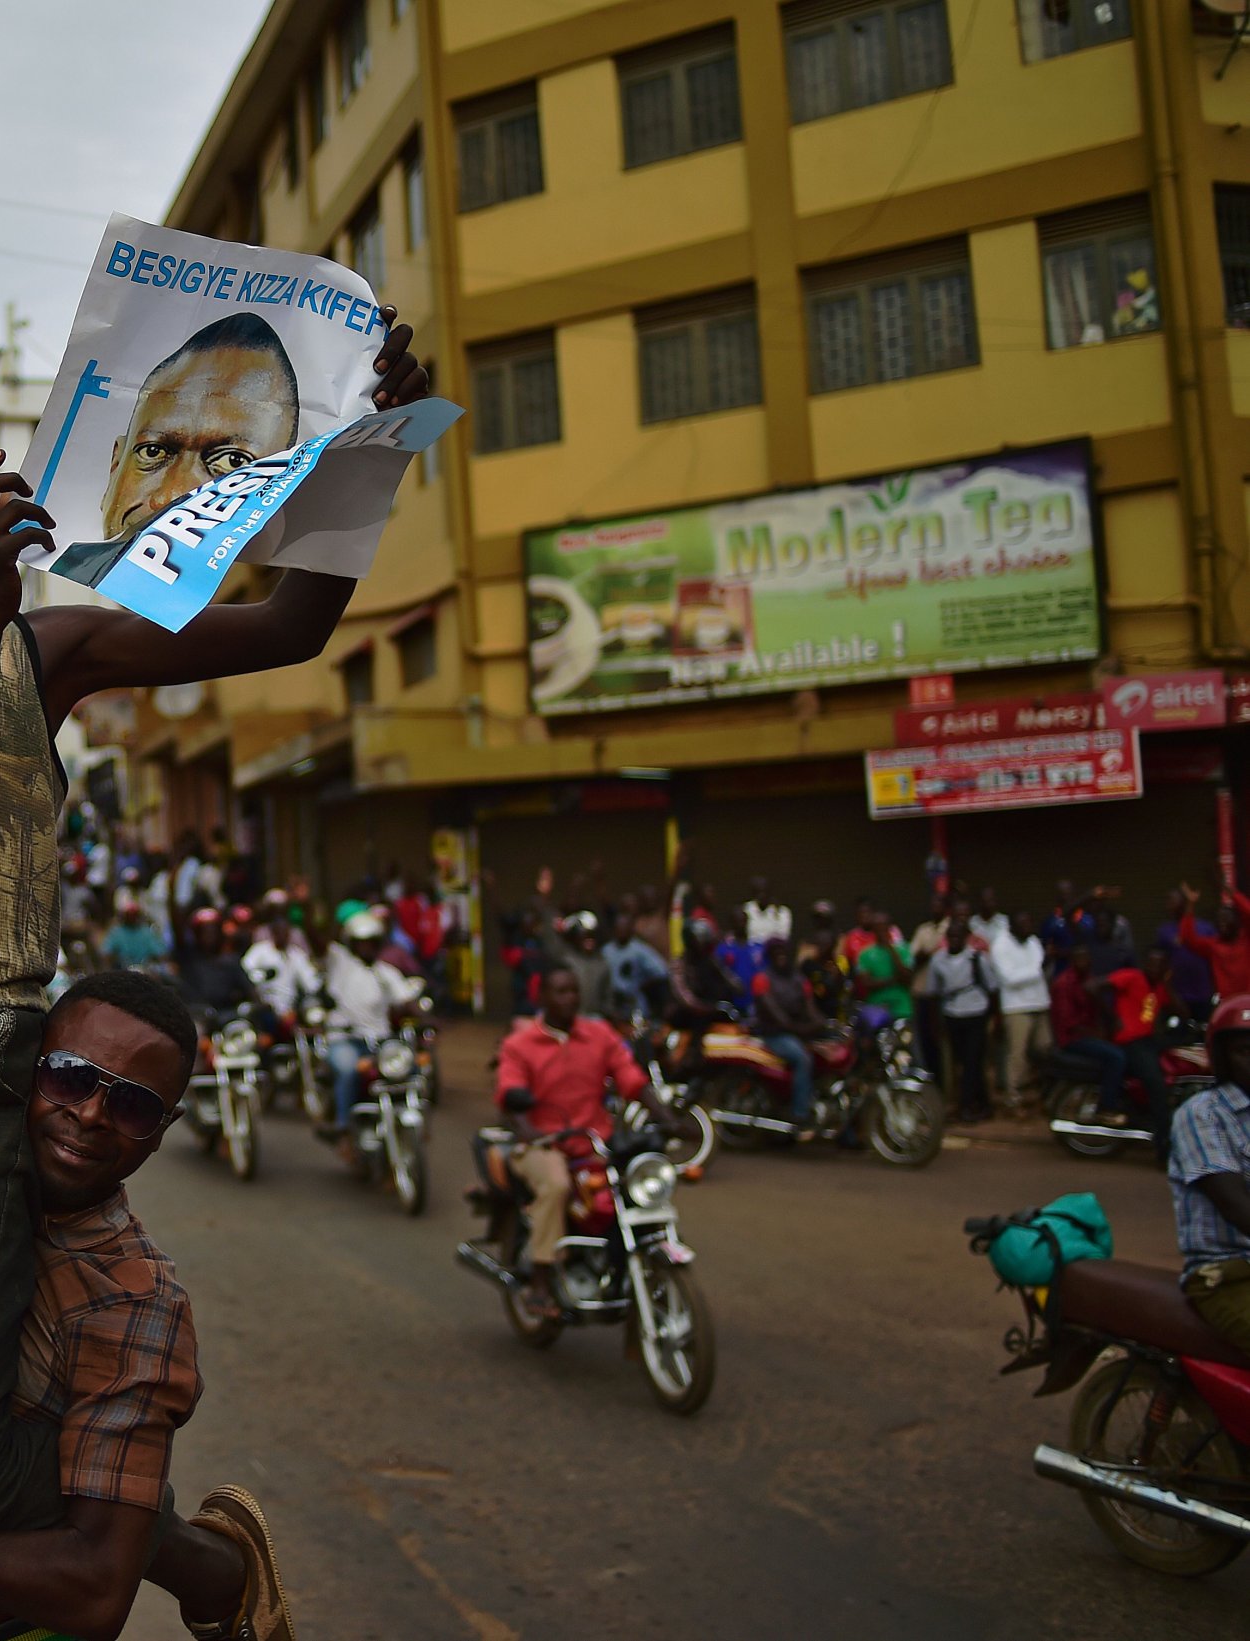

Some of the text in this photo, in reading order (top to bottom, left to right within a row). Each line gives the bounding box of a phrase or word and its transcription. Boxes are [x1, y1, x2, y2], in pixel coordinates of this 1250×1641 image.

[106, 240, 238, 299] BESIGYE
[236, 271, 299, 305] KIZZA
[126, 440, 304, 586] PRESI
[207, 536, 238, 571] FOR
[233, 508, 264, 534] THE
[261, 453, 315, 507] CHANGE
[726, 507, 945, 577] Modern
[961, 487, 1074, 547] Tea
[918, 554, 974, 584] best
[984, 544, 1072, 578] choice
[739, 634, 879, 676] Available
[1151, 680, 1215, 708] airtel
